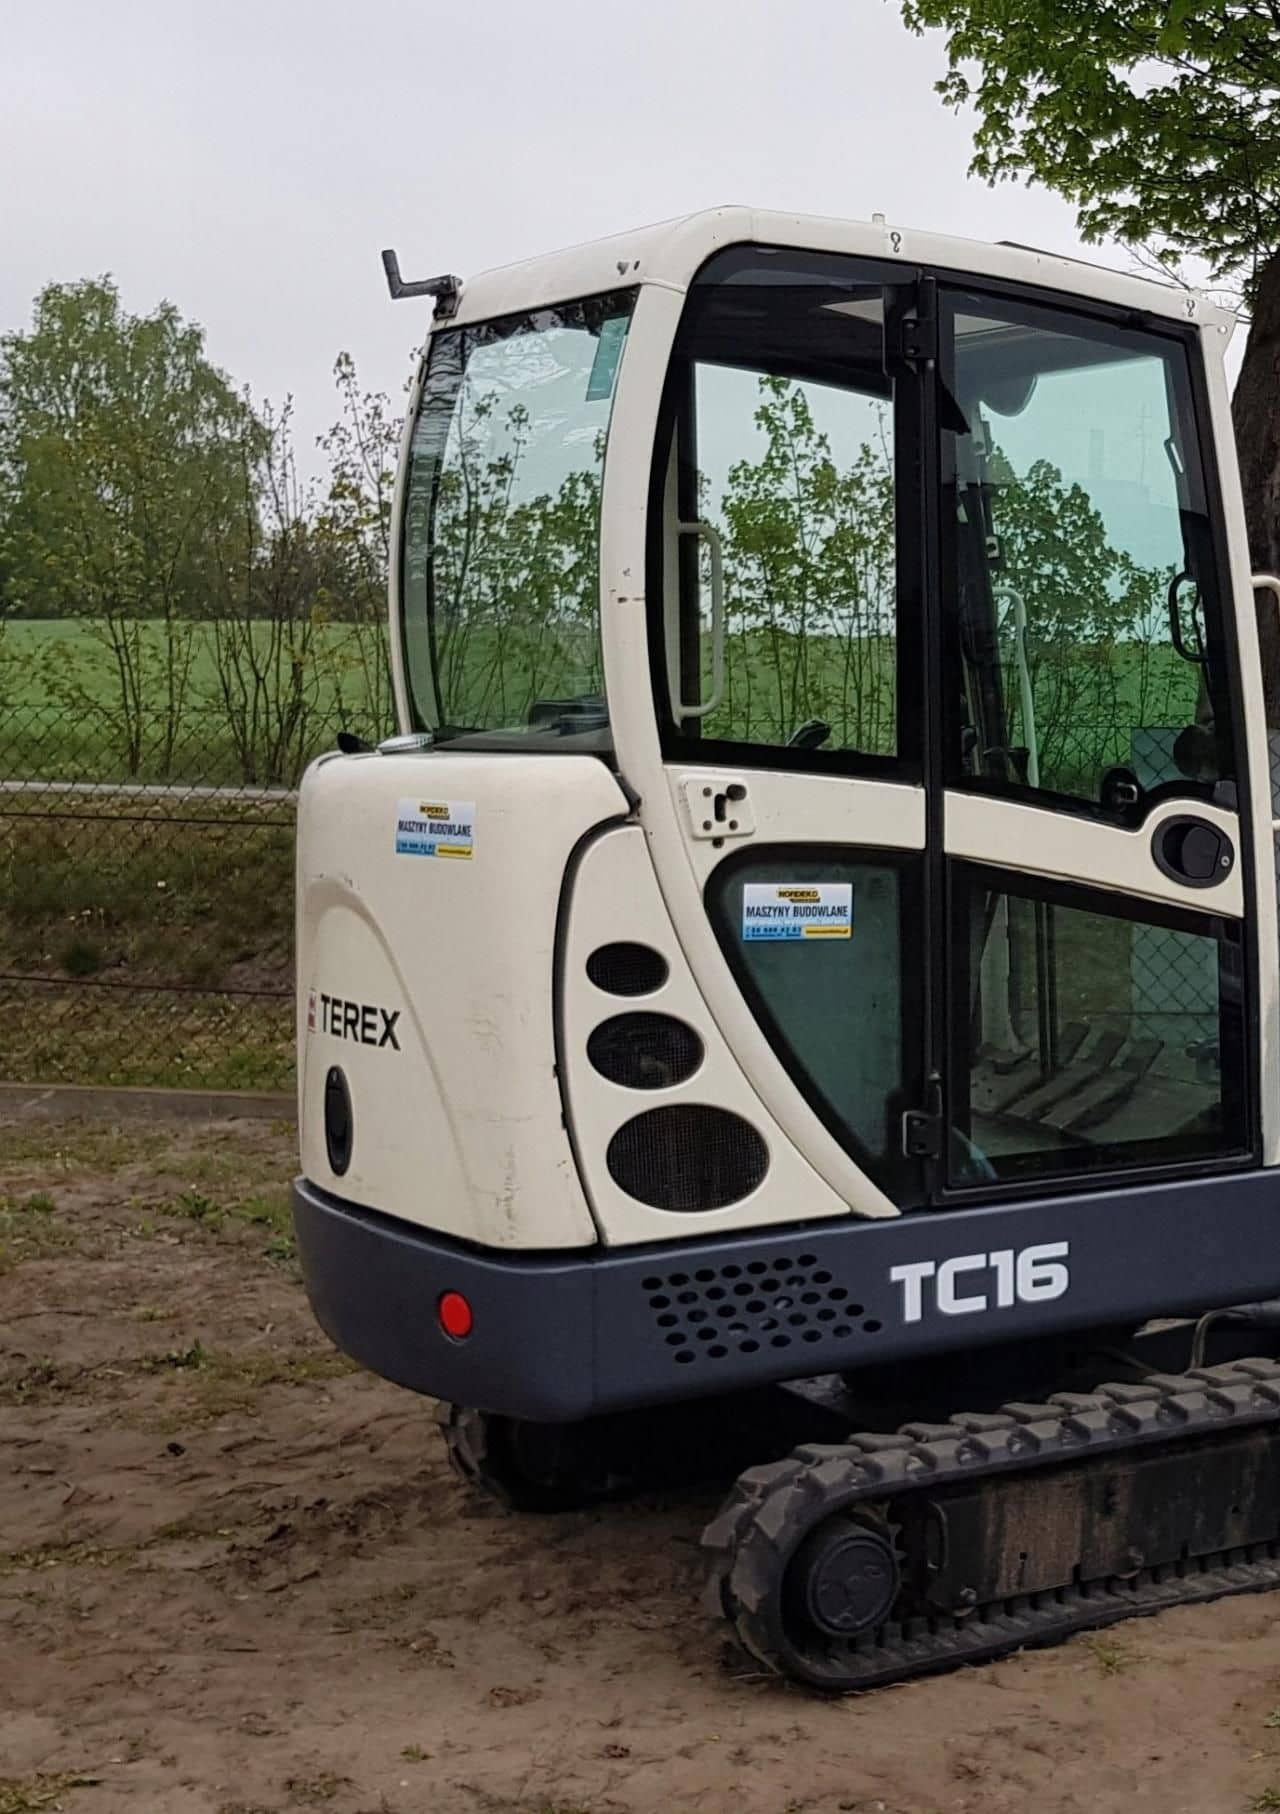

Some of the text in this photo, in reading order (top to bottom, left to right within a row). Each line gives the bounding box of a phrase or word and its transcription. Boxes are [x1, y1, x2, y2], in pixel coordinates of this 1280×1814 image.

[746, 905, 849, 918] MASZYNY BUDOWLANE
[320, 992, 401, 1052] TEREX
[889, 1241, 1069, 1322] TC16
